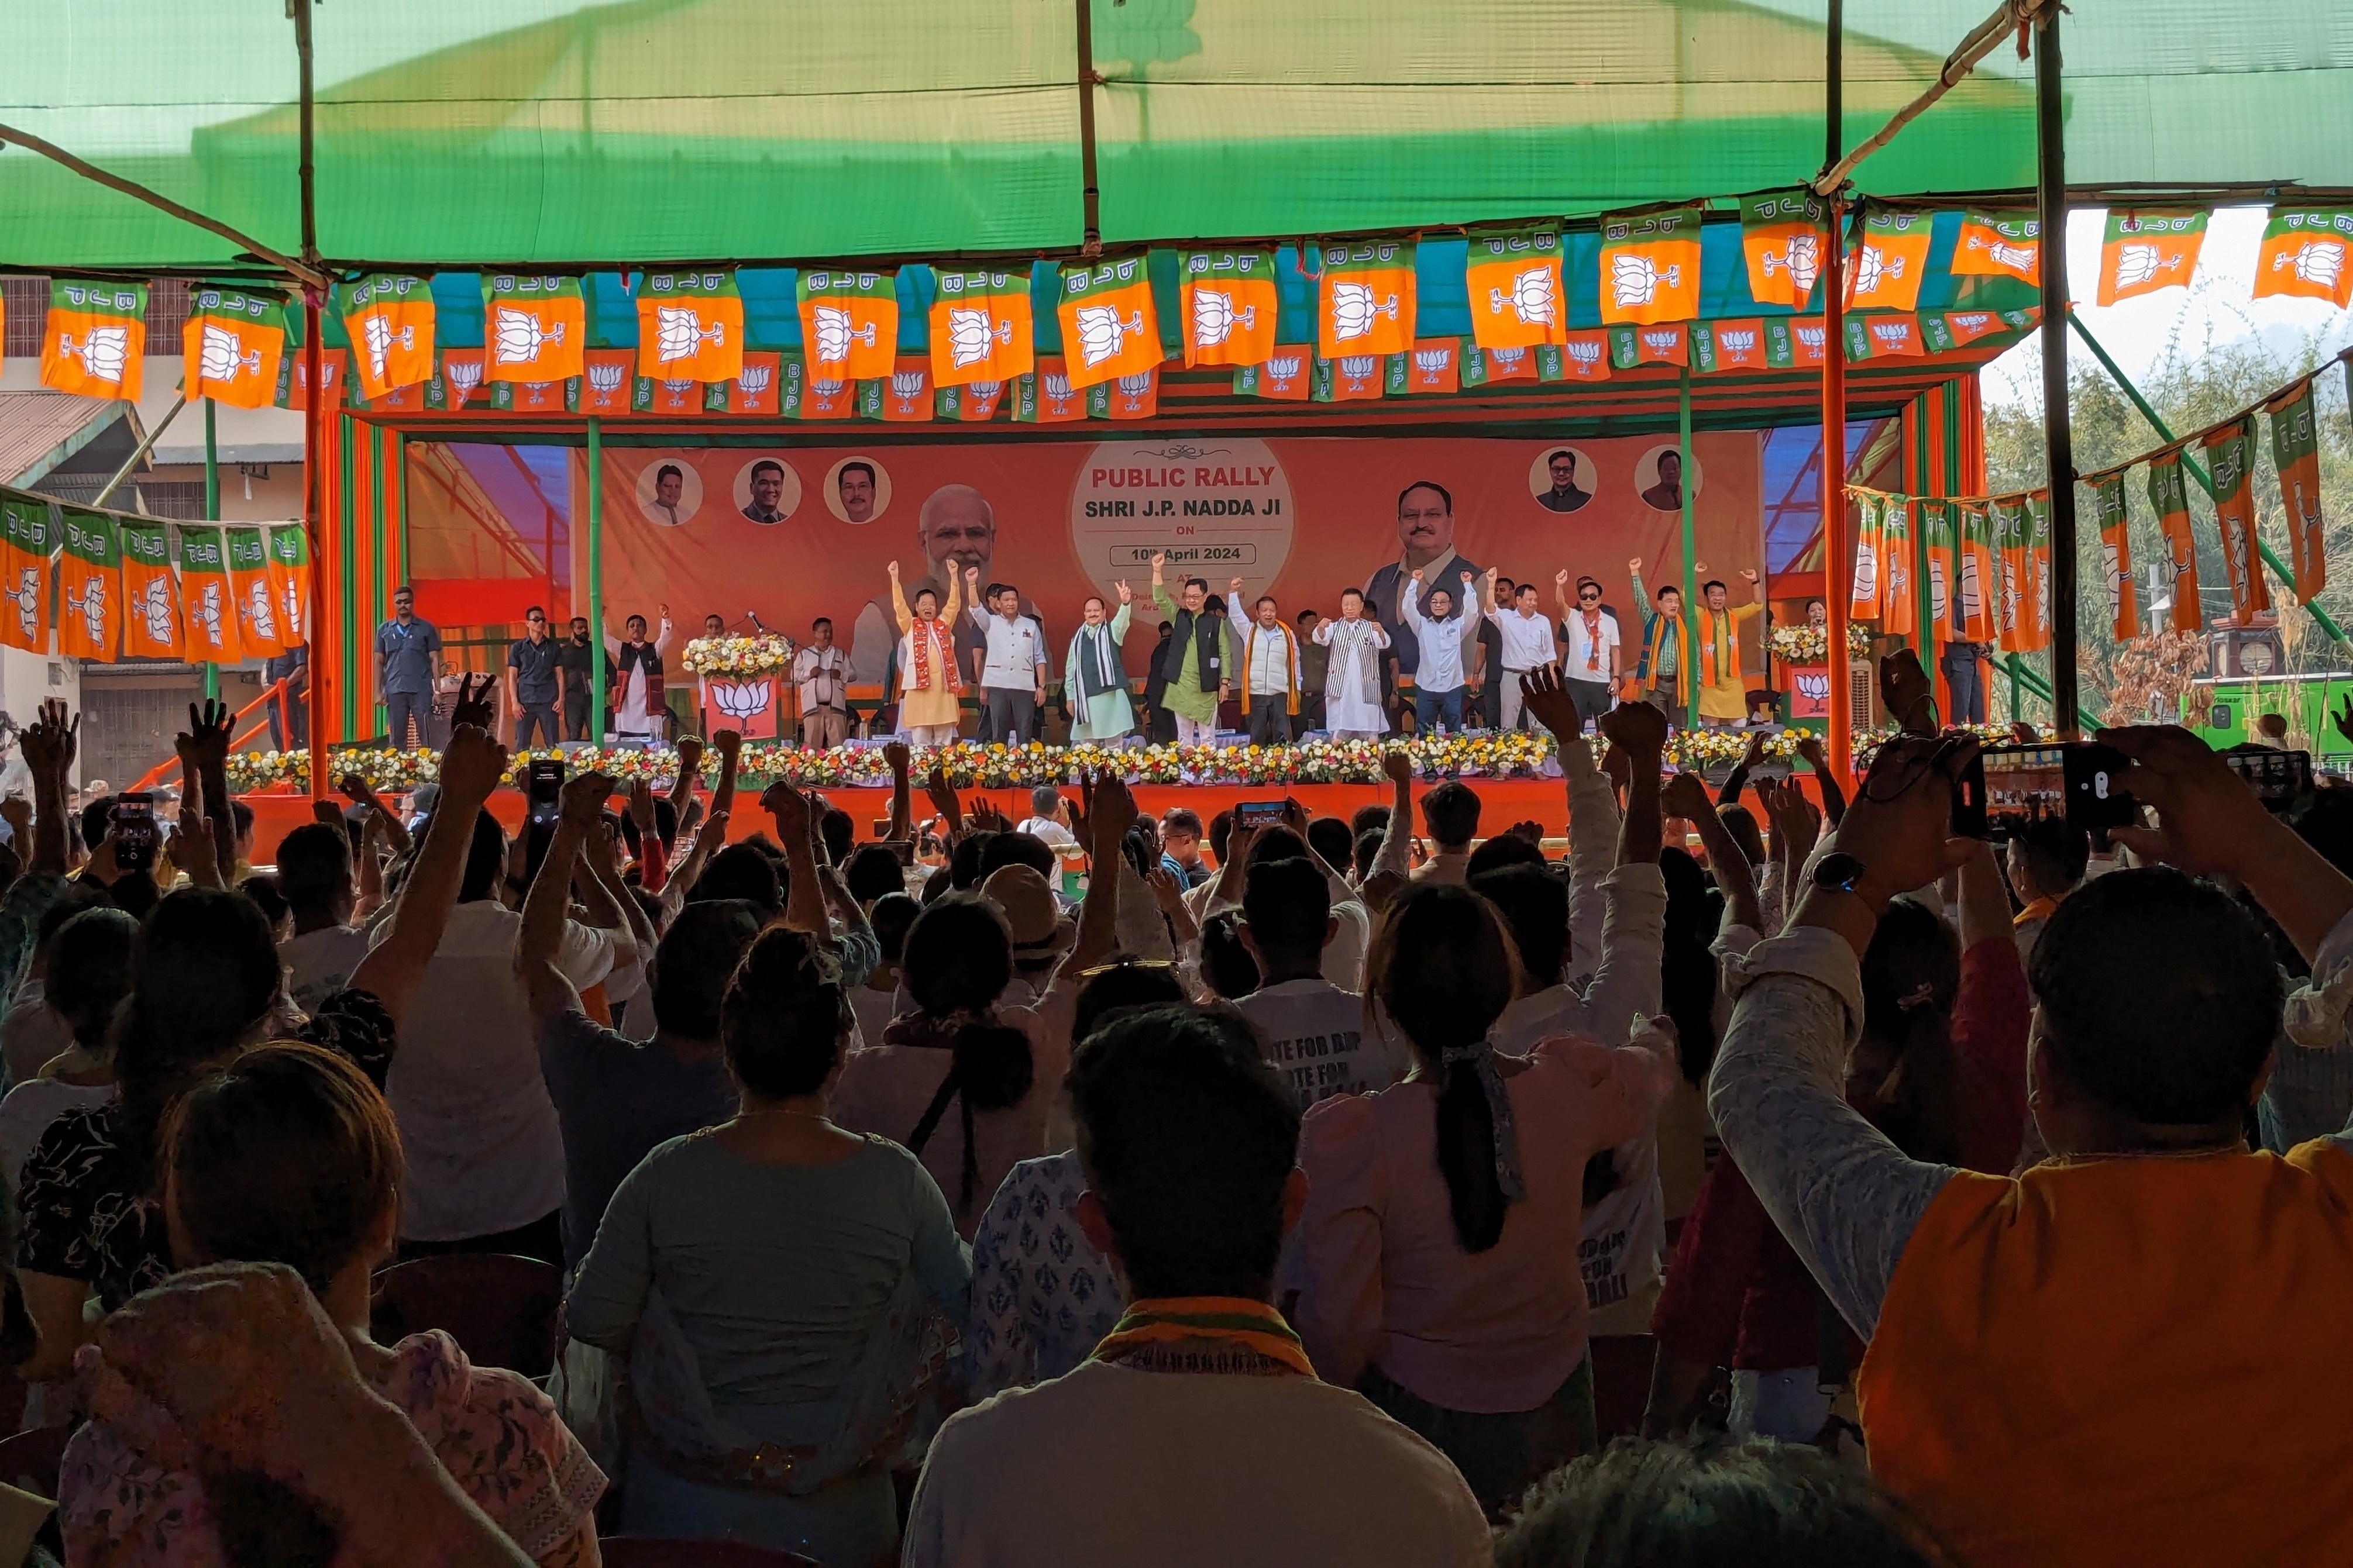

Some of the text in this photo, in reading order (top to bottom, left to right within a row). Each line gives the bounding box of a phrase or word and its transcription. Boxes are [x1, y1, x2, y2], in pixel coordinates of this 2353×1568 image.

[1482, 232, 1556, 253] BJP
[65, 286, 137, 311] BJP
[1621, 332, 1634, 363] BJP
[1697, 329, 1711, 366] BJP
[1849, 323, 1866, 356] BJP
[275, 358, 289, 400] BJP
[786, 364, 800, 409] BJP
[1243, 366, 1254, 388] JP
[567, 376, 576, 406] JP
[638, 378, 649, 406] JP
[714, 381, 725, 406] JP
[868, 378, 879, 412] JP
[946, 386, 957, 412] JP
[1094, 383, 1105, 411] JP
[1092, 466, 1275, 488] PUBLIC RALLY
[1085, 499, 1281, 517] SHRI J.P. NADDA JI
[68, 523, 105, 556] BJP
[1176, 526, 1195, 535] ON
[1165, 547, 1199, 563] April
[1203, 547, 1241, 560] 2024
[1272, 1040, 1294, 1060] TE
[1296, 1036, 1329, 1059] FOR
